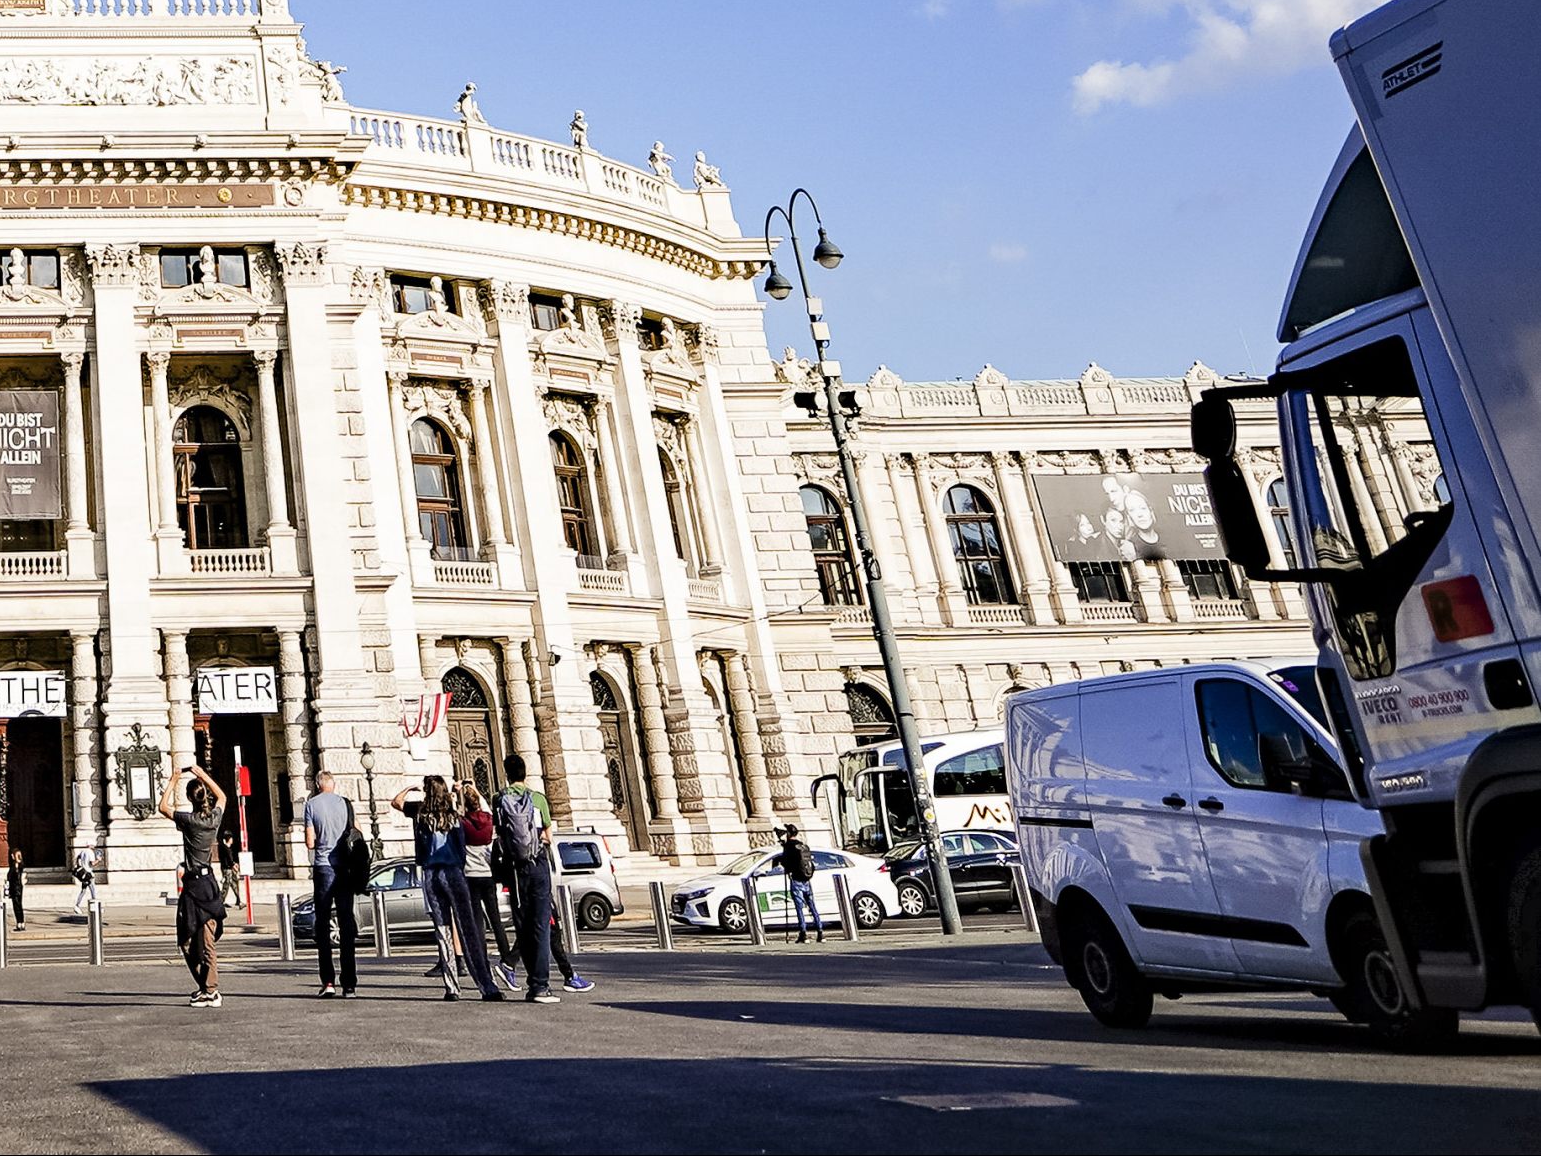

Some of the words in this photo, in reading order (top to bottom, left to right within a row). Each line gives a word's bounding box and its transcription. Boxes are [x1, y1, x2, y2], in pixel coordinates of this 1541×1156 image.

[1383, 62, 1422, 92] ATHLET
[16, 412, 43, 427] BIST
[0, 450, 42, 465] ALLEIN
[1172, 483, 1188, 496] DU
[198, 673, 273, 701] ATER
[1361, 695, 1398, 717] IVECO
[1408, 696, 1428, 710] 0800
